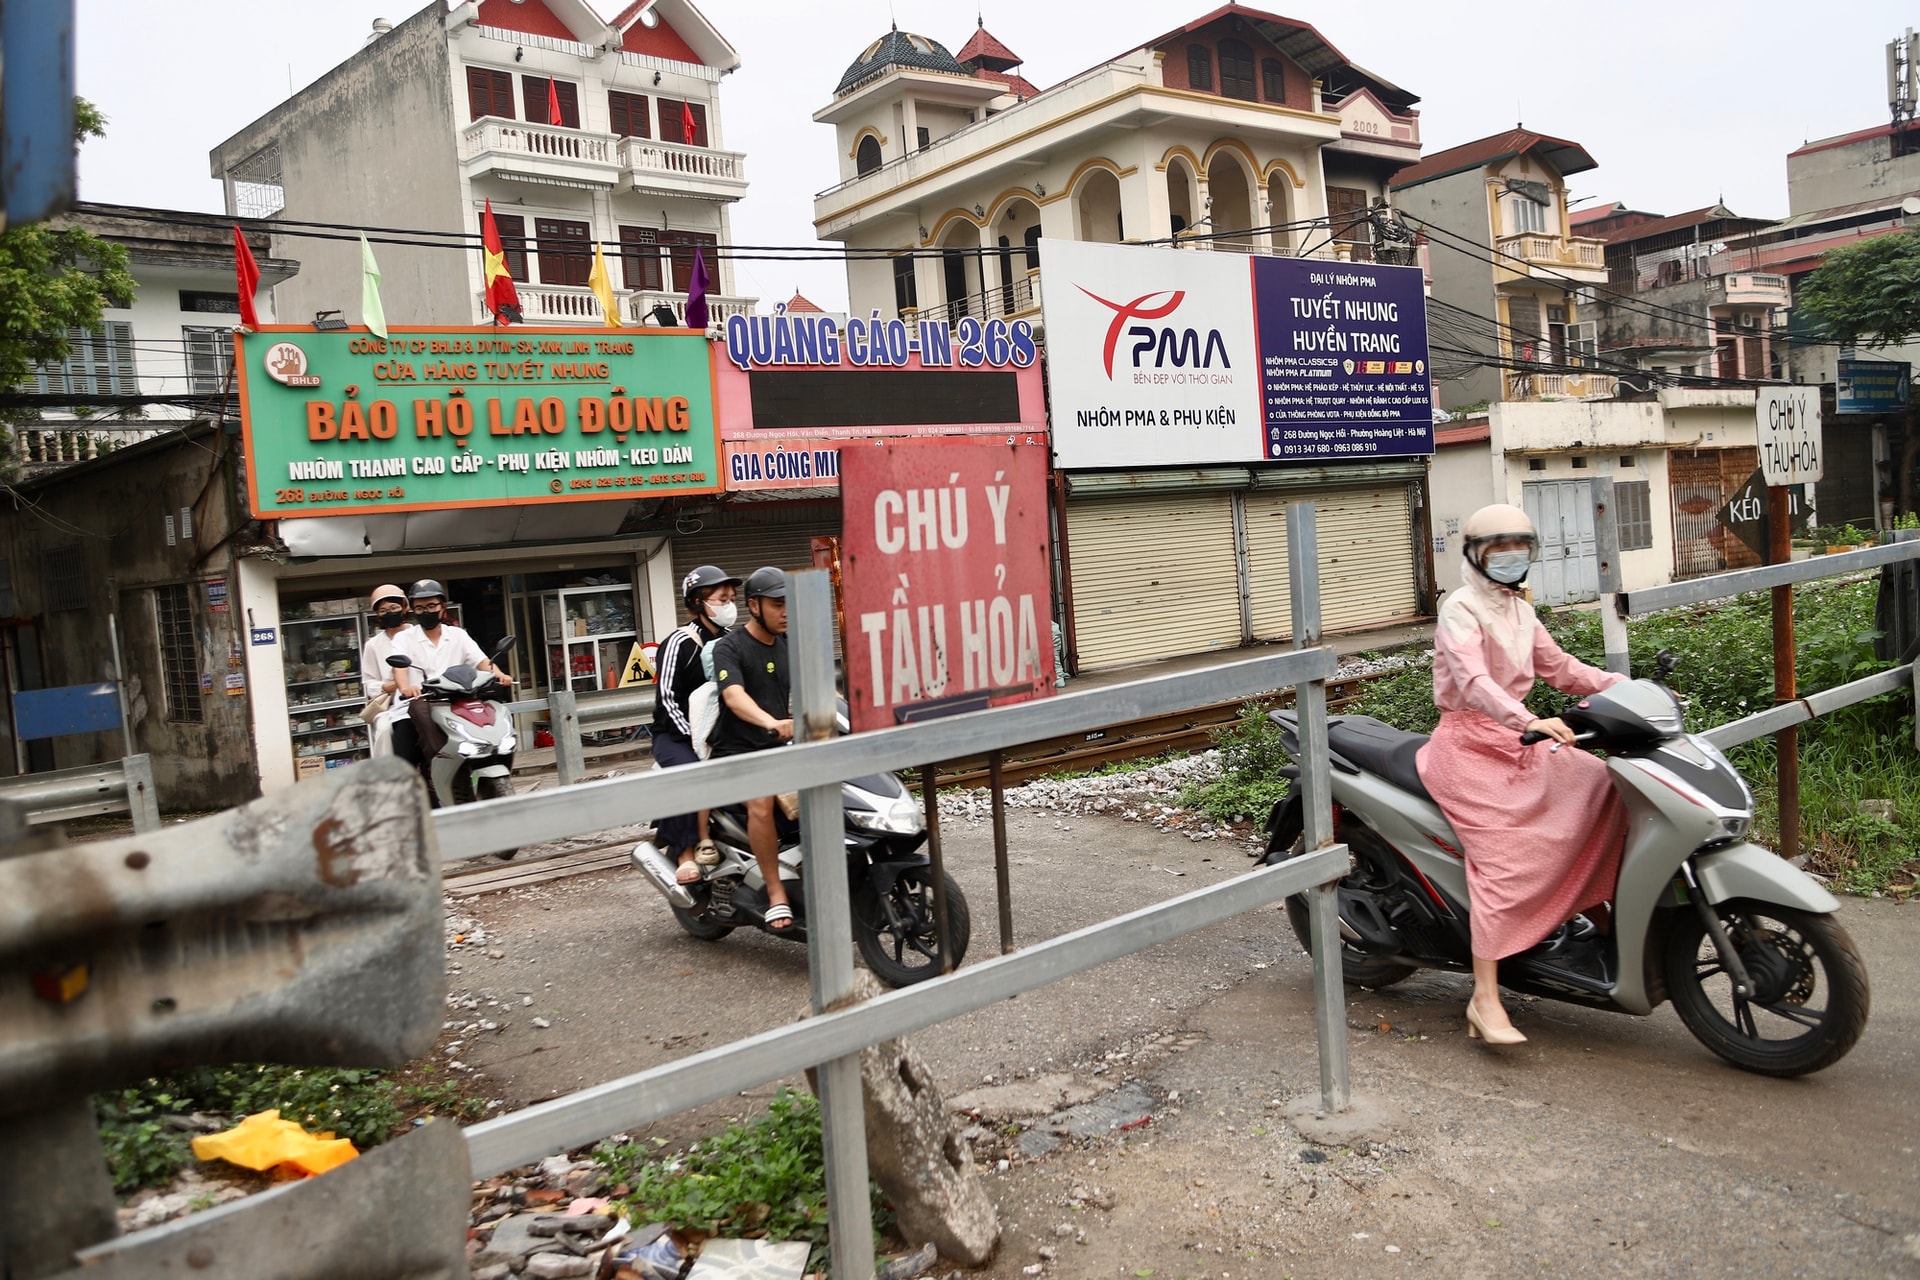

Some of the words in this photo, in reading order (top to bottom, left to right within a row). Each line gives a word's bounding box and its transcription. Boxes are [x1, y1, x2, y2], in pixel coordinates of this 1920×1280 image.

[1353, 120, 1378, 135] 2002
[1310, 272, 1324, 286] ĐẠI
[1325, 272, 1335, 285] LÝ
[1336, 273, 1359, 286] NHÔM
[1360, 276, 1376, 287] PMA
[1290, 291, 1341, 319] TUYẾT
[1345, 300, 1398, 322] NHUNG
[350, 337, 388, 354] CÔNG
[390, 340, 407, 354] TY
[409, 340, 426, 353] CP
[430, 340, 463, 354] BHLĐ
[465, 340, 473, 353] &
[565, 341, 590, 354] LINH
[595, 341, 635, 354] TRANG
[726, 302, 841, 371] QUẢNG
[958, 317, 1037, 368] 268
[1128, 326, 1231, 369] PMA
[1293, 324, 1347, 352] HUYỀN
[1350, 332, 1400, 353] TRANG
[374, 358, 416, 380] CỬA
[423, 359, 478, 380] HÀNG
[551, 362, 610, 379] NHUNG
[1265, 355, 1283, 365] NHÔM
[1284, 357, 1297, 365] PMA
[1266, 367, 1284, 377] NHÔM
[1285, 369, 1298, 377] PMA
[292, 376, 320, 385] BHLĐ
[1154, 373, 1169, 386] ĐẸP
[1210, 374, 1233, 384] GIAN
[306, 384, 398, 441] BẢO
[413, 387, 474, 447] HỘ
[487, 396, 566, 436] LAO
[578, 386, 691, 442] ĐỘNG
[1077, 406, 1121, 427] NHÔM
[1125, 410, 1156, 426] PMA
[1159, 410, 1170, 426] &
[1173, 410, 1202, 429] PHỤ
[1205, 405, 1236, 429] KIỆN
[1769, 393, 1795, 431] CHÚ
[1798, 393, 1806, 429] Ý
[1283, 430, 1297, 440] 268
[1319, 429, 1335, 440] Ngọc
[1407, 427, 1416, 436] Hà
[1284, 444, 1302, 454] 0913
[1303, 444, 1316, 453] 347
[1317, 444, 1330, 453] 680
[1334, 443, 1351, 453] 0963
[1351, 443, 1364, 452] 086
[1364, 443, 1378, 452] 910
[1765, 435, 1789, 474] TÀU
[1792, 430, 1818, 472] HỎA
[289, 456, 344, 480] NHÔM
[348, 457, 407, 478] THANH
[411, 456, 446, 475] CAO
[450, 449, 484, 474] CẤP
[497, 453, 530, 474] PHỤ
[535, 448, 570, 473] KIỆN
[575, 446, 620, 469] NHÔM
[630, 449, 659, 466] KEO
[663, 443, 694, 464] DÁN
[731, 452, 763, 482] GIA
[763, 444, 812, 480] CÔNG
[276, 487, 305, 504] 268
[309, 490, 349, 502] ĐƯỜNG
[353, 490, 383, 501] NGỌC
[1729, 486, 1761, 523] KÉO
[874, 472, 969, 555] CHÚ
[985, 470, 1011, 545] Ý
[253, 632, 274, 643] 268
[861, 573, 949, 707] TẦU
[960, 563, 1042, 692] HỎA
